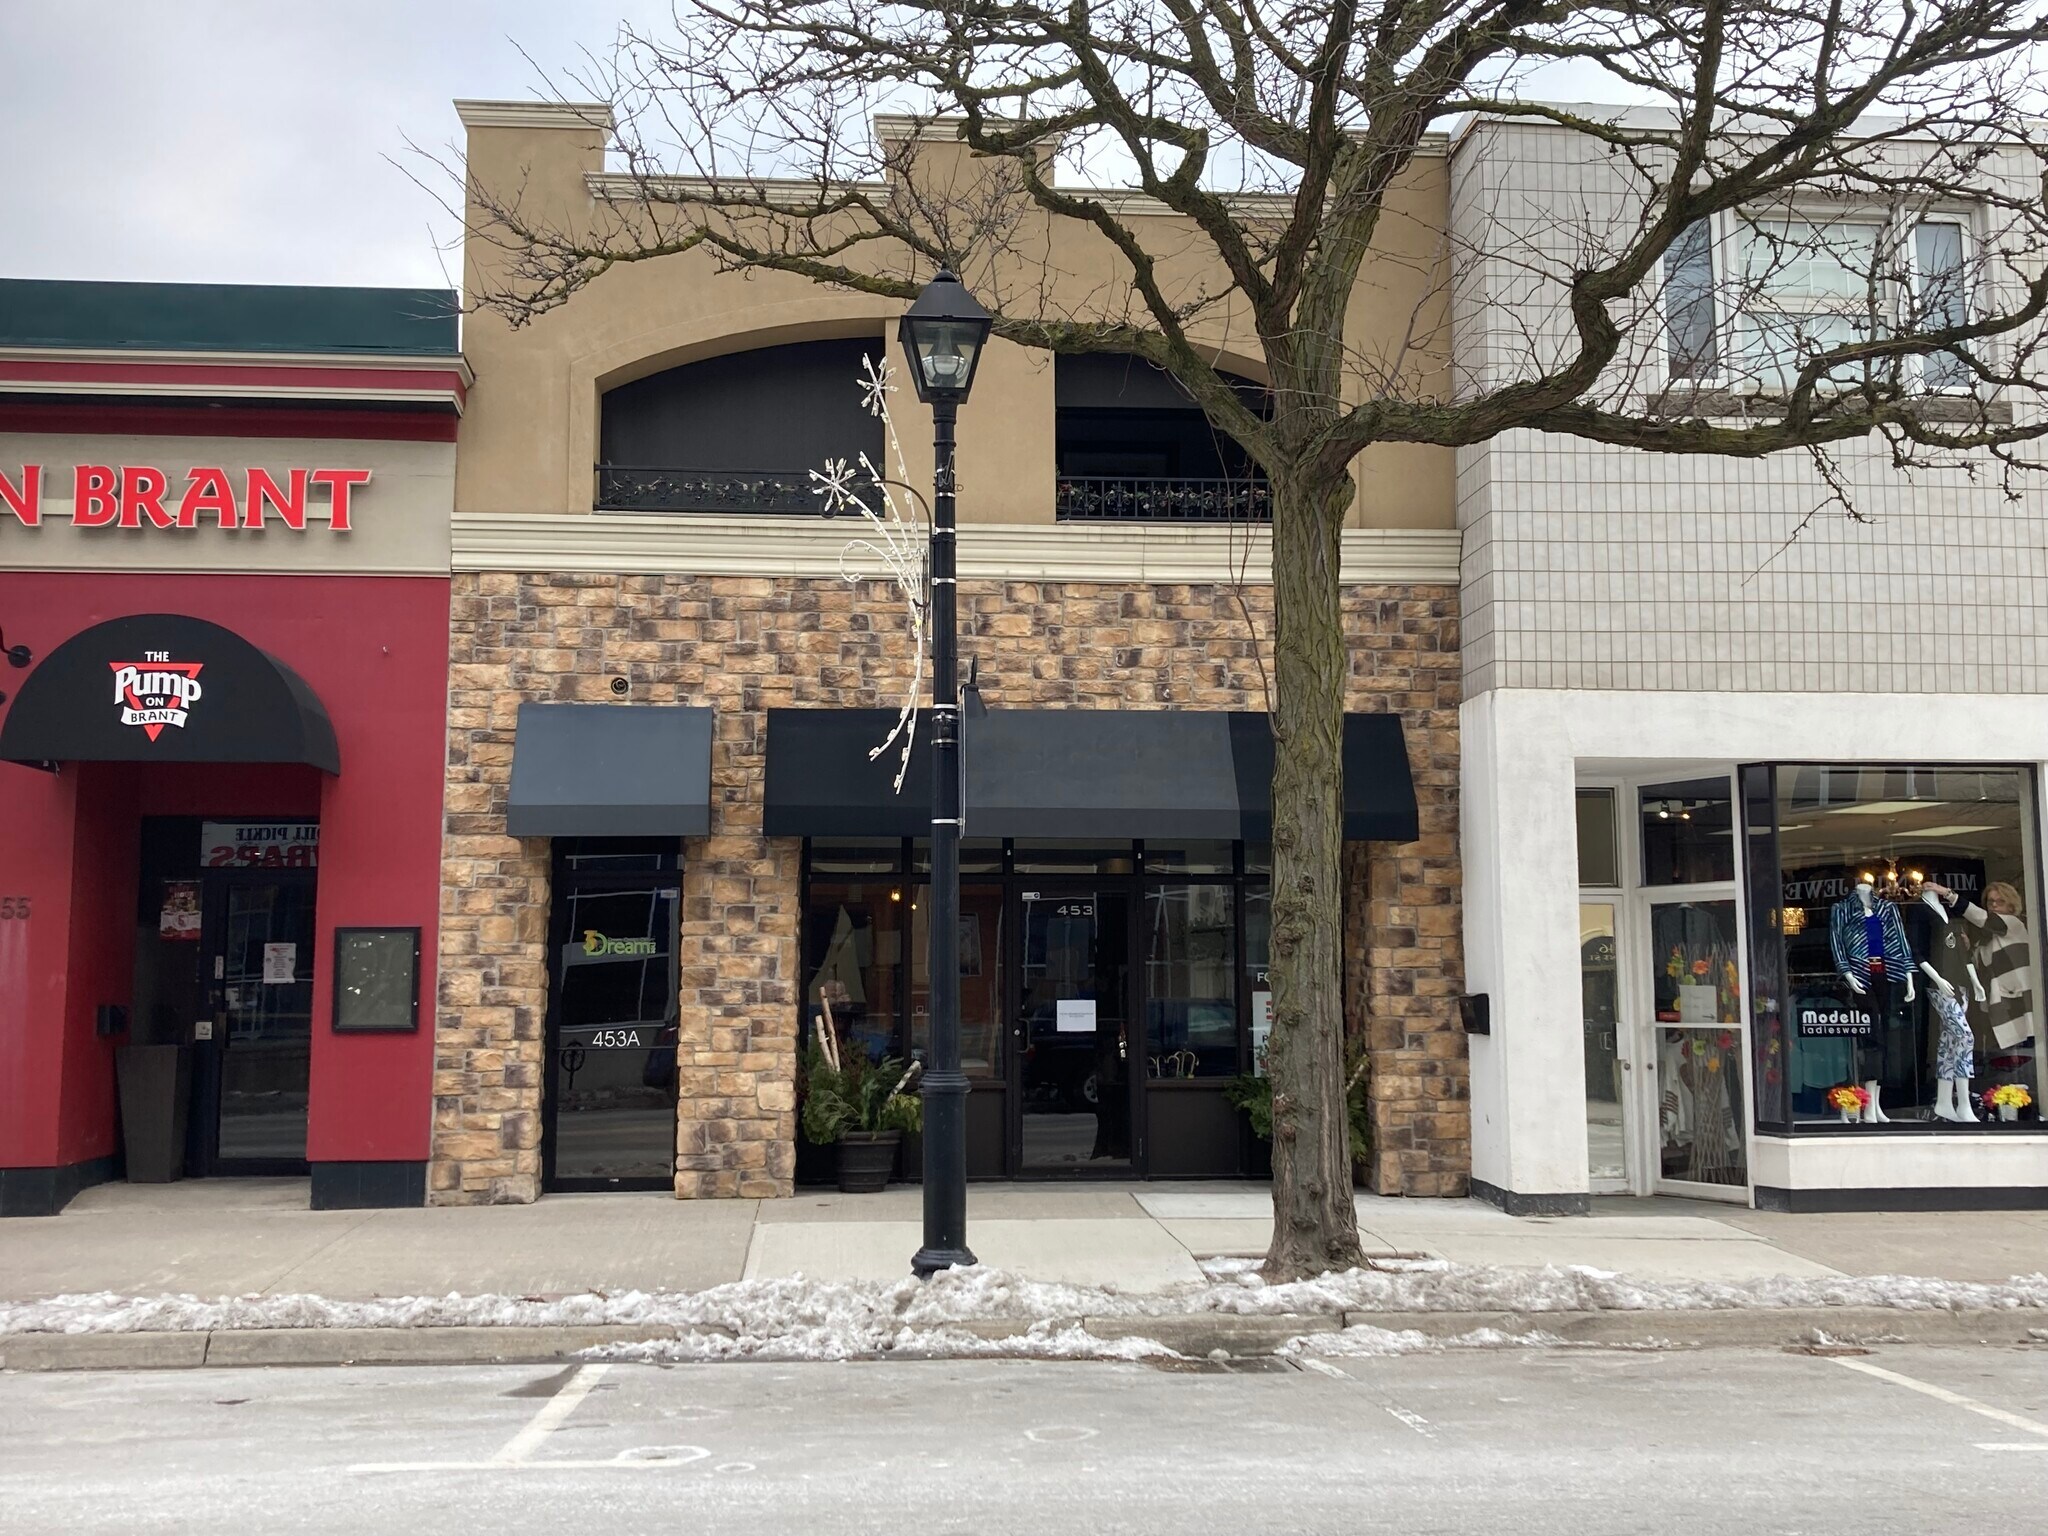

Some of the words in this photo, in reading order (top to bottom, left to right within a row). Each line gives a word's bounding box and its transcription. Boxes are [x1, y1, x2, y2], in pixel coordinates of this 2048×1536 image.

[71, 465, 373, 531] BRANT
[144, 651, 170, 662] THE
[114, 665, 202, 710] Pump
[145, 697, 164, 707] ON
[131, 711, 178, 722] BRANT
[1056, 905, 1093, 916] 453
[1802, 1010, 1871, 1024] Modella
[1802, 1026, 1871, 1035] ladieswear
[592, 1030, 641, 1047] 453A
